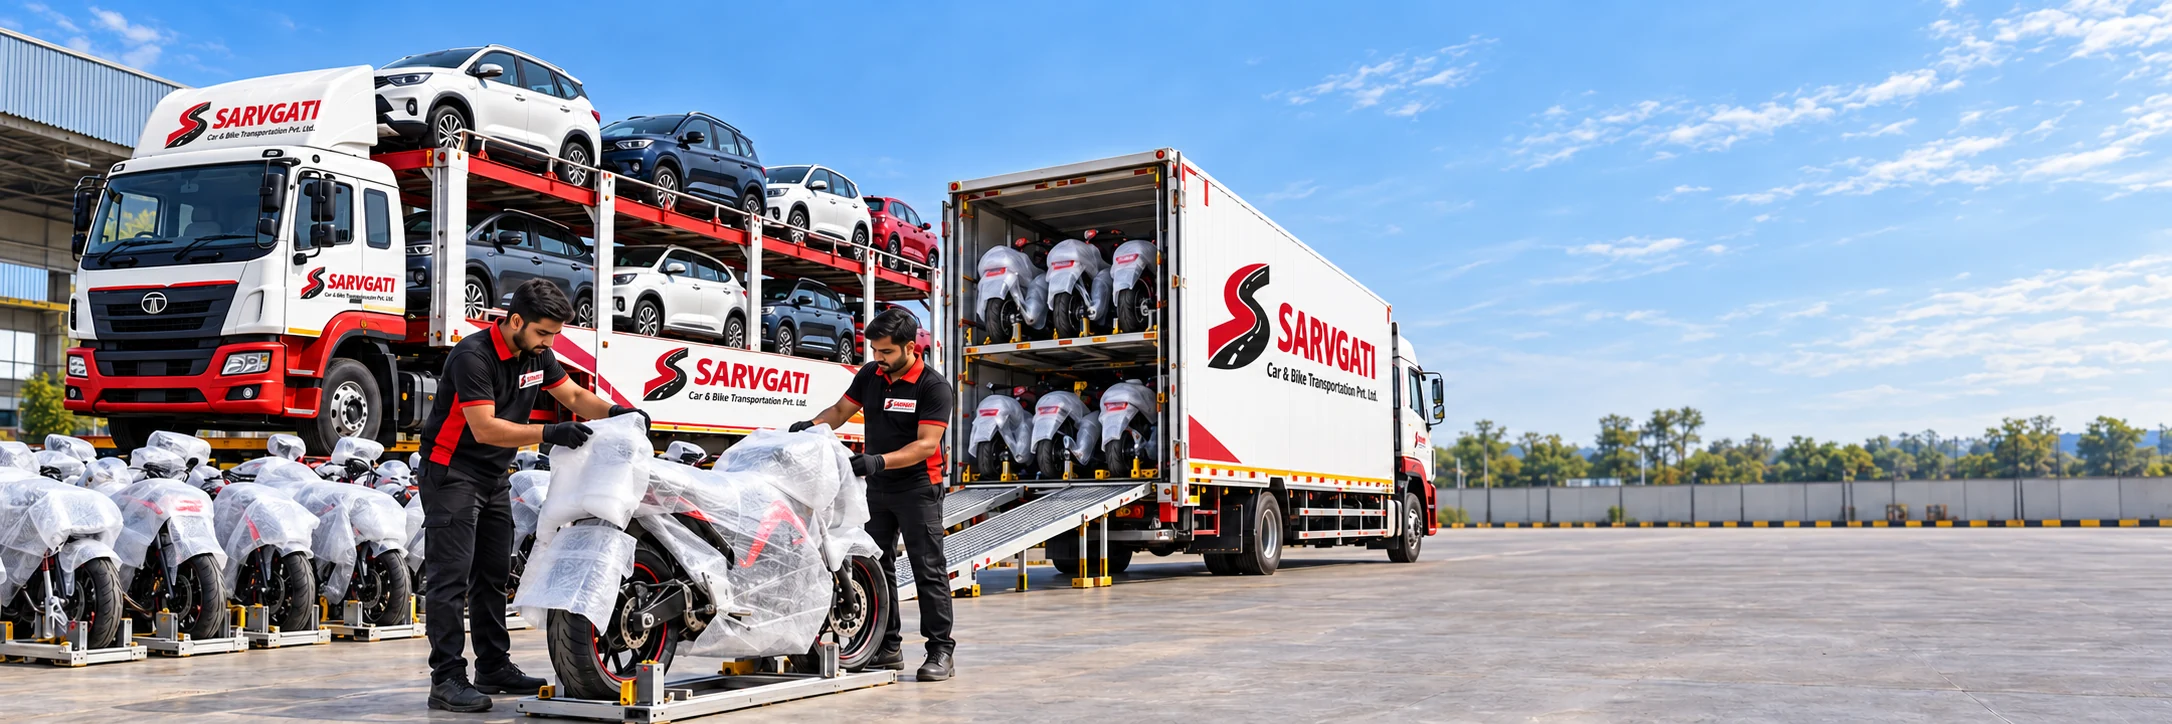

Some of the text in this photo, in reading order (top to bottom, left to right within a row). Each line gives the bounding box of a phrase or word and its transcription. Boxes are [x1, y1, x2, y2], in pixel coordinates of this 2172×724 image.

[212, 100, 322, 129] SARVGATI
[207, 123, 316, 141] Car & Bike Transportation Pvt. Ltd.
[328, 273, 395, 293] SARVGATI
[1277, 302, 1376, 380] SARVGATI
[694, 358, 810, 395] SARVGATI
[1267, 362, 1378, 402] Car & Bike Transportation Pvt. Ltd.
[688, 390, 704, 400] Car
[712, 392, 729, 402] Bike
[731, 393, 782, 405] Transportation
[782, 397, 795, 406] Pvt.
[796, 399, 808, 407] Ltd.
